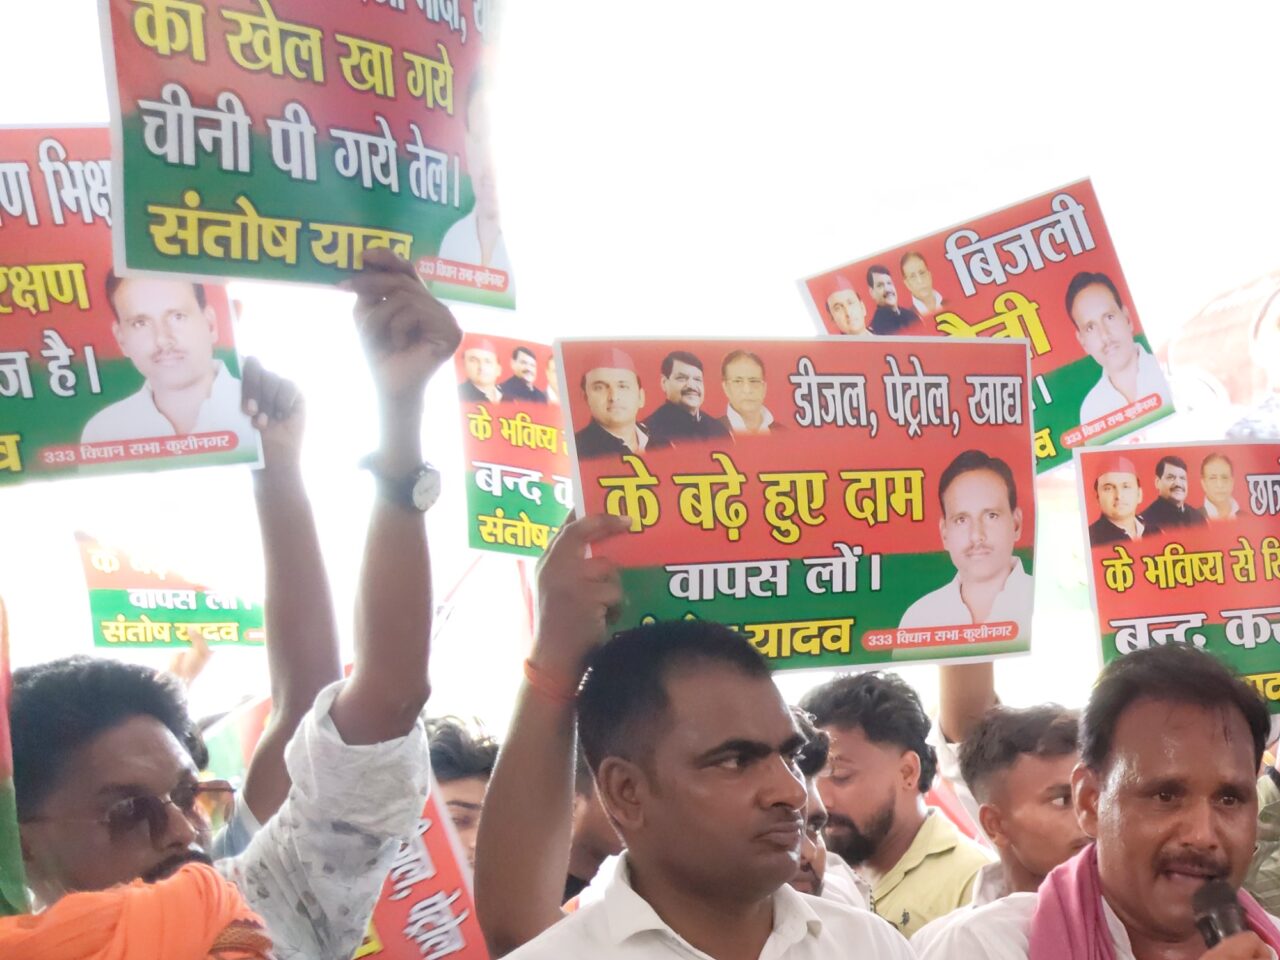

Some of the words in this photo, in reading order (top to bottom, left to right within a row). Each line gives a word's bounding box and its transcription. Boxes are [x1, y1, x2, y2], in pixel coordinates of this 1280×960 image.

[220, 0, 325, 83] खेल
[335, 34, 396, 98] खा
[403, 43, 455, 115] गये
[138, 83, 252, 174] चीनी
[266, 102, 318, 181] पी
[329, 115, 400, 193] गये
[38, 138, 112, 228] भिक्ष
[147, 191, 302, 265] संतोष
[944, 193, 1097, 298] बिजली
[0, 262, 91, 316] रक्षण
[41, 328, 102, 398] है।
[788, 359, 878, 437] डीजल,
[883, 356, 960, 437] पेट्रोल,
[964, 373, 1023, 425] खाद्य
[466, 404, 493, 441] के
[499, 411, 559, 454] भविष्य
[471, 460, 544, 506] बन्द
[599, 455, 660, 534] के
[758, 470, 829, 544] हुए
[840, 468, 925, 527] दाम
[477, 506, 551, 550] संतोष
[665, 558, 790, 602] वापस
[1102, 545, 1135, 592] के
[1142, 543, 1225, 589] भविष्य
[1230, 537, 1257, 582] से
[100, 613, 172, 643] संतोष
[742, 618, 855, 658] यादव
[867, 633, 893, 647] 333
[896, 629, 931, 645] विधान
